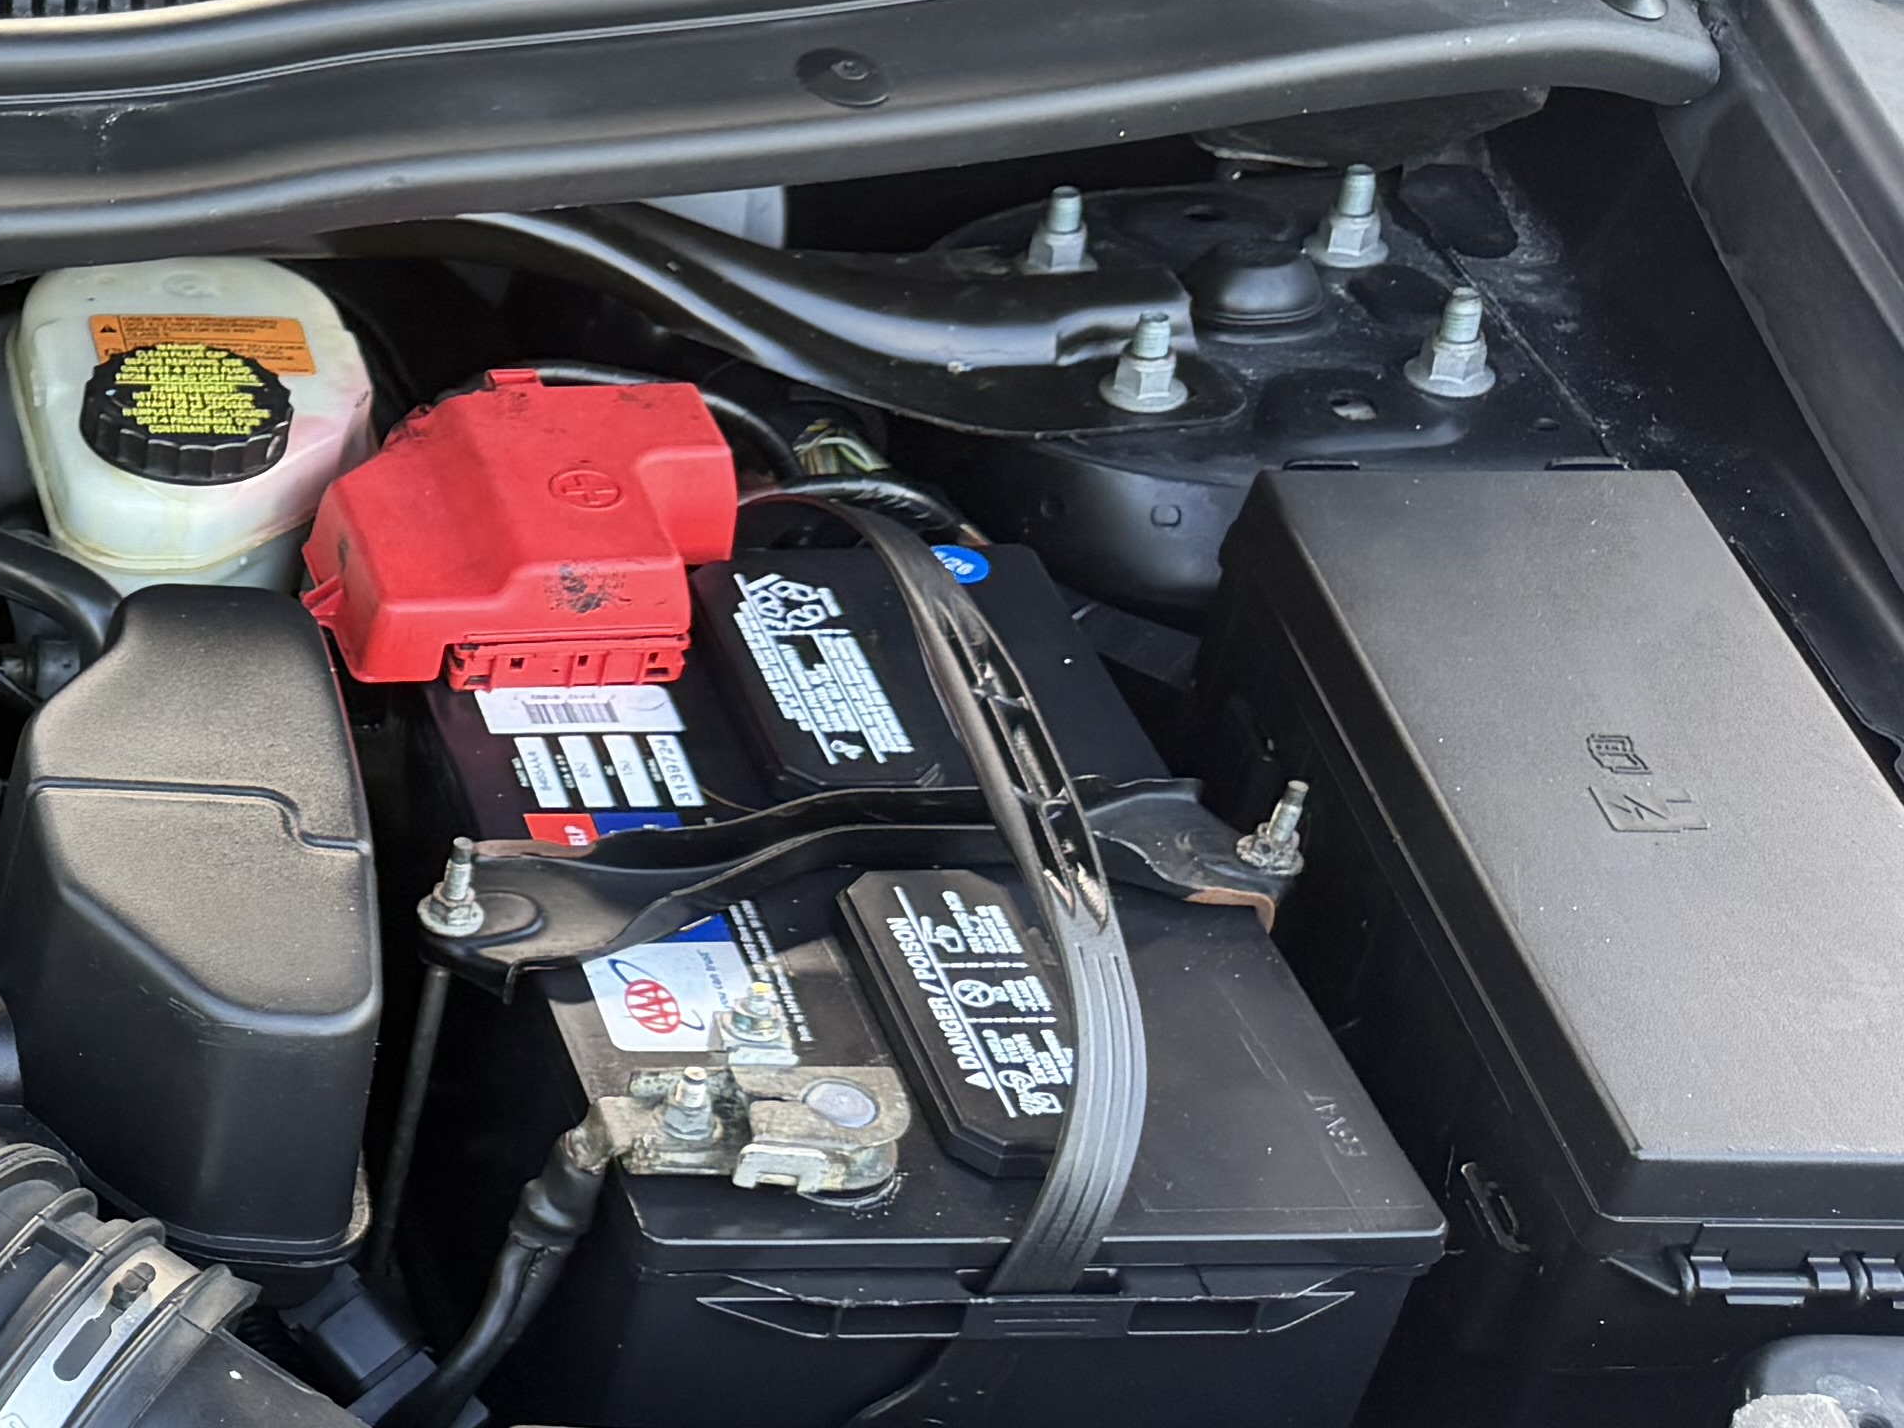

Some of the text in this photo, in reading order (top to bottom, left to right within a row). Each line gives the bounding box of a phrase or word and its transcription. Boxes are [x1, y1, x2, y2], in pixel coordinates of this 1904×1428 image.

[886, 917, 938, 980] POISON
[626, 980, 680, 1033] AAA
[927, 996, 984, 1070] DANGER
